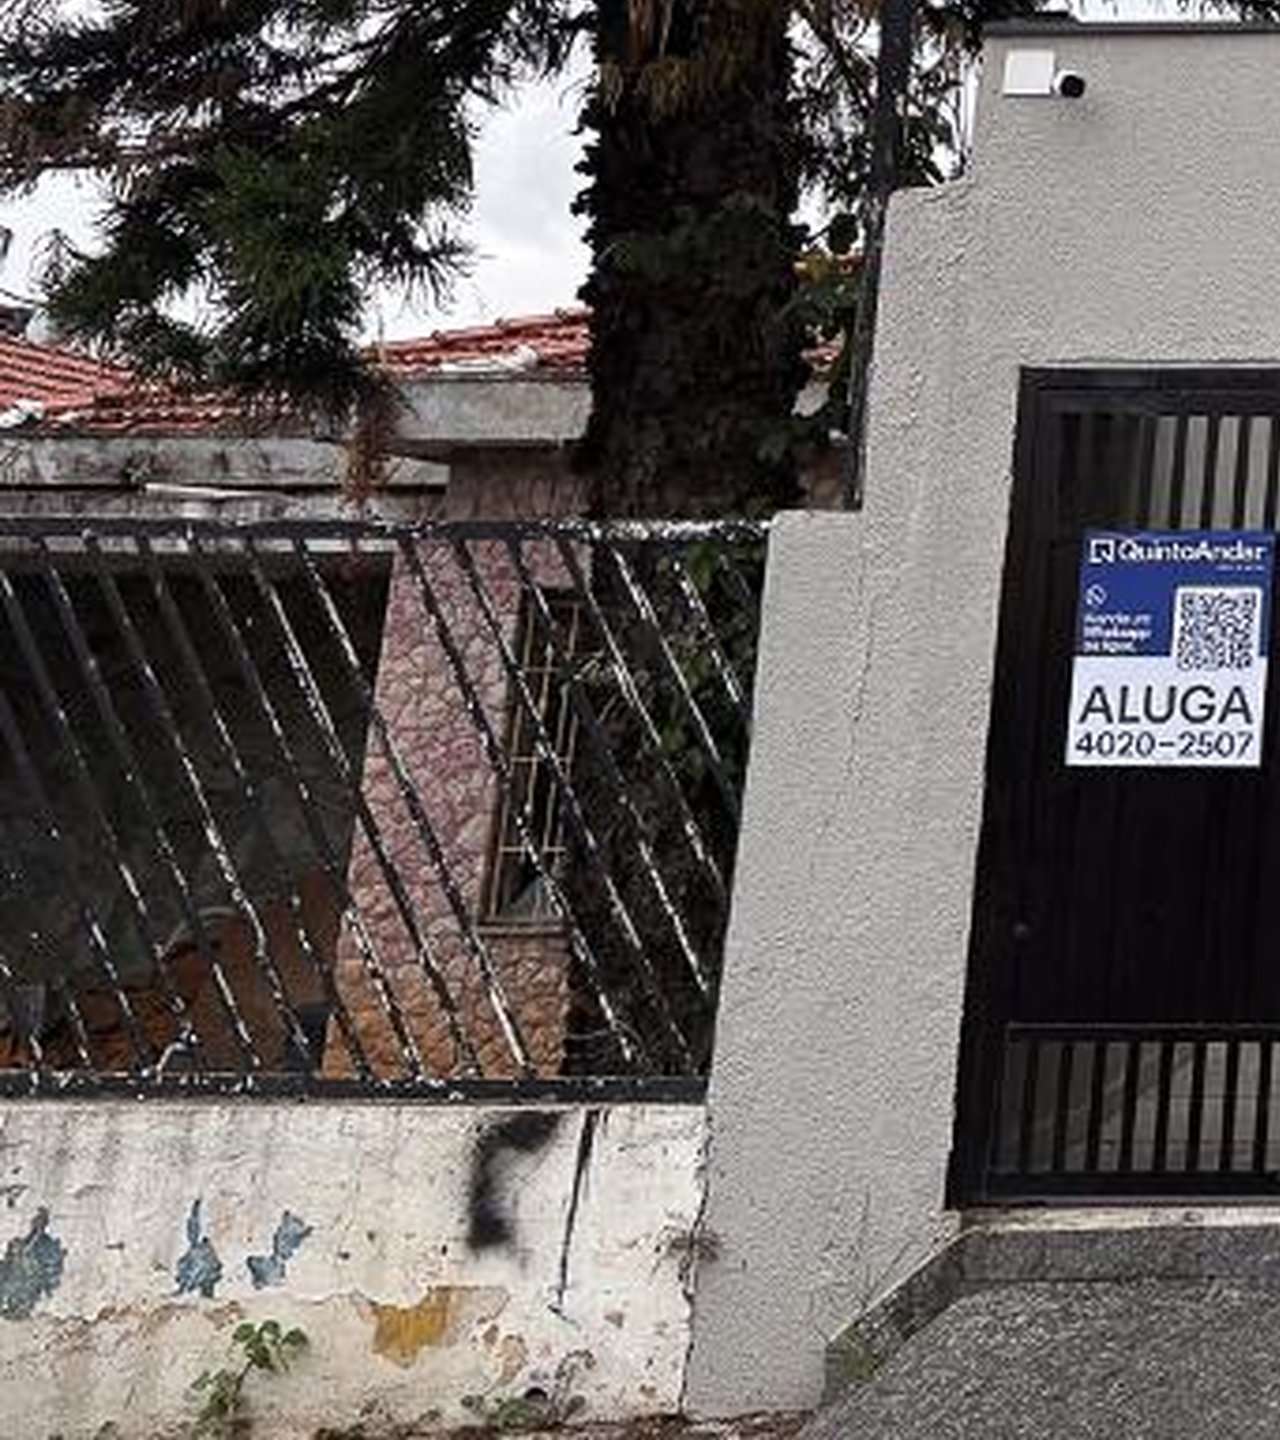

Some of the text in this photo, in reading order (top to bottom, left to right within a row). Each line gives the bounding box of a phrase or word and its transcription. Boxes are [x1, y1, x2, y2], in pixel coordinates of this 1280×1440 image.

[1118, 539, 1268, 561] QuintoAndar
[1078, 684, 1254, 725] ALUGA
[1075, 730, 1255, 758] 4020-2507
